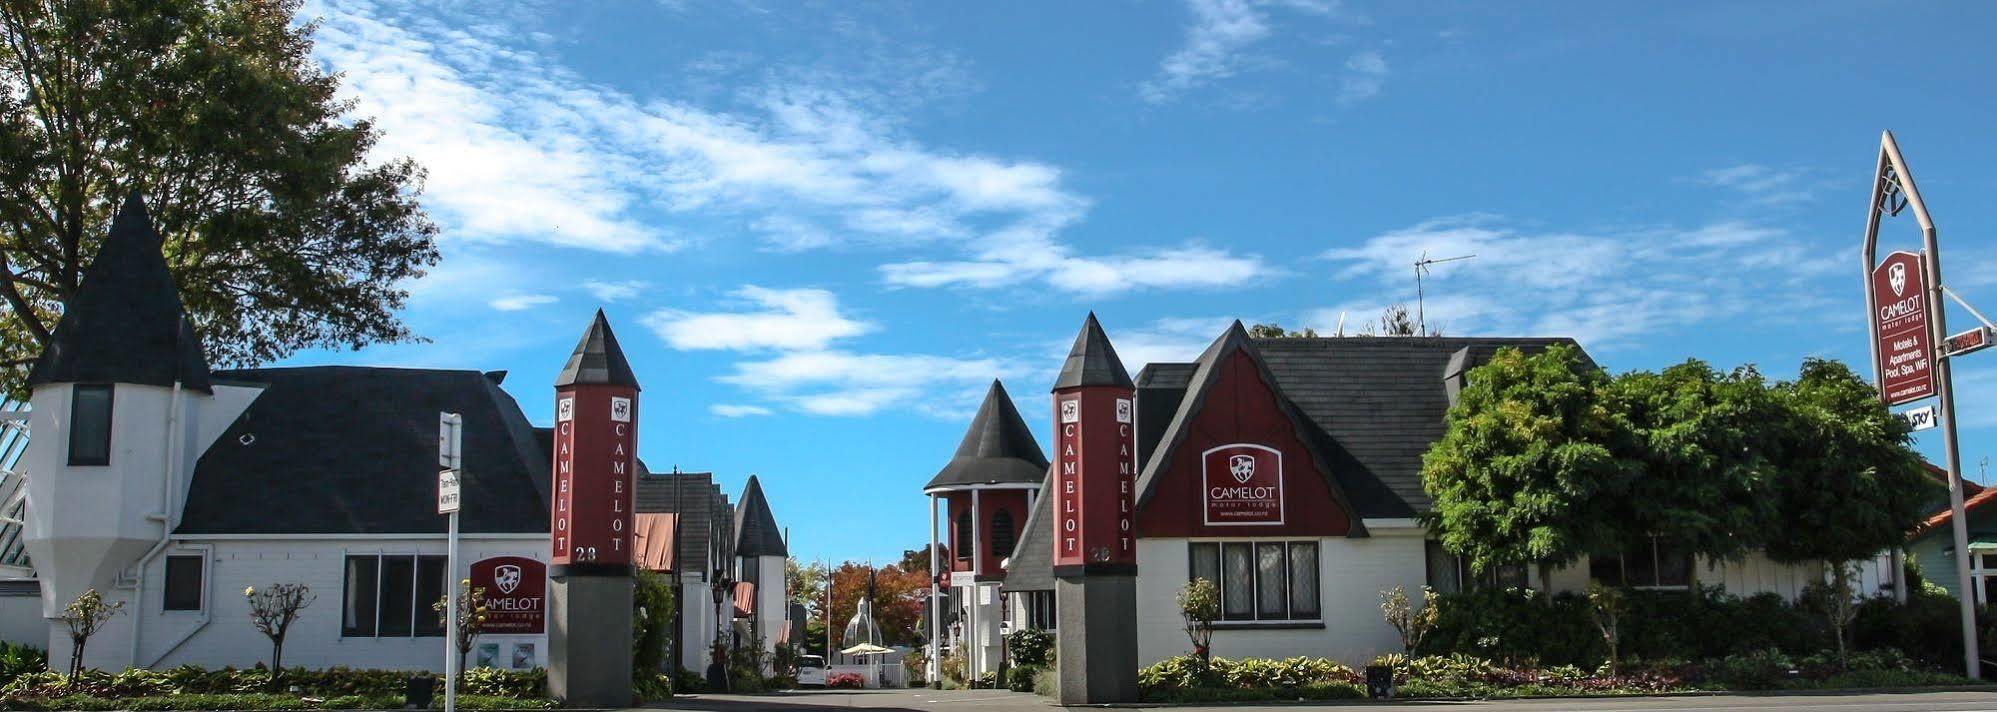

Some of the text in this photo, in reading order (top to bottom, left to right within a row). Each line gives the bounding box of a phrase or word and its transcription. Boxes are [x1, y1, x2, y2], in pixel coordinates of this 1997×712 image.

[1881, 294, 1920, 320] CAMELOT
[1882, 312, 1922, 330] motor lodge
[1893, 335, 1918, 351] Motels &
[1889, 348, 1922, 366] Apartments
[1885, 367, 1900, 379] Pool,
[1901, 364, 1915, 376] Spa,
[1890, 384, 1927, 398] www.camelot.co.nz
[1911, 410, 1930, 428] SKY
[557, 423, 570, 550] CAMELOT
[613, 423, 625, 551] CAMELOT
[1064, 424, 1076, 551] CAMELOT
[1119, 424, 1130, 551] CAMELOT
[1210, 486, 1276, 500] CAMELOT
[1247, 501, 1276, 509] lodge
